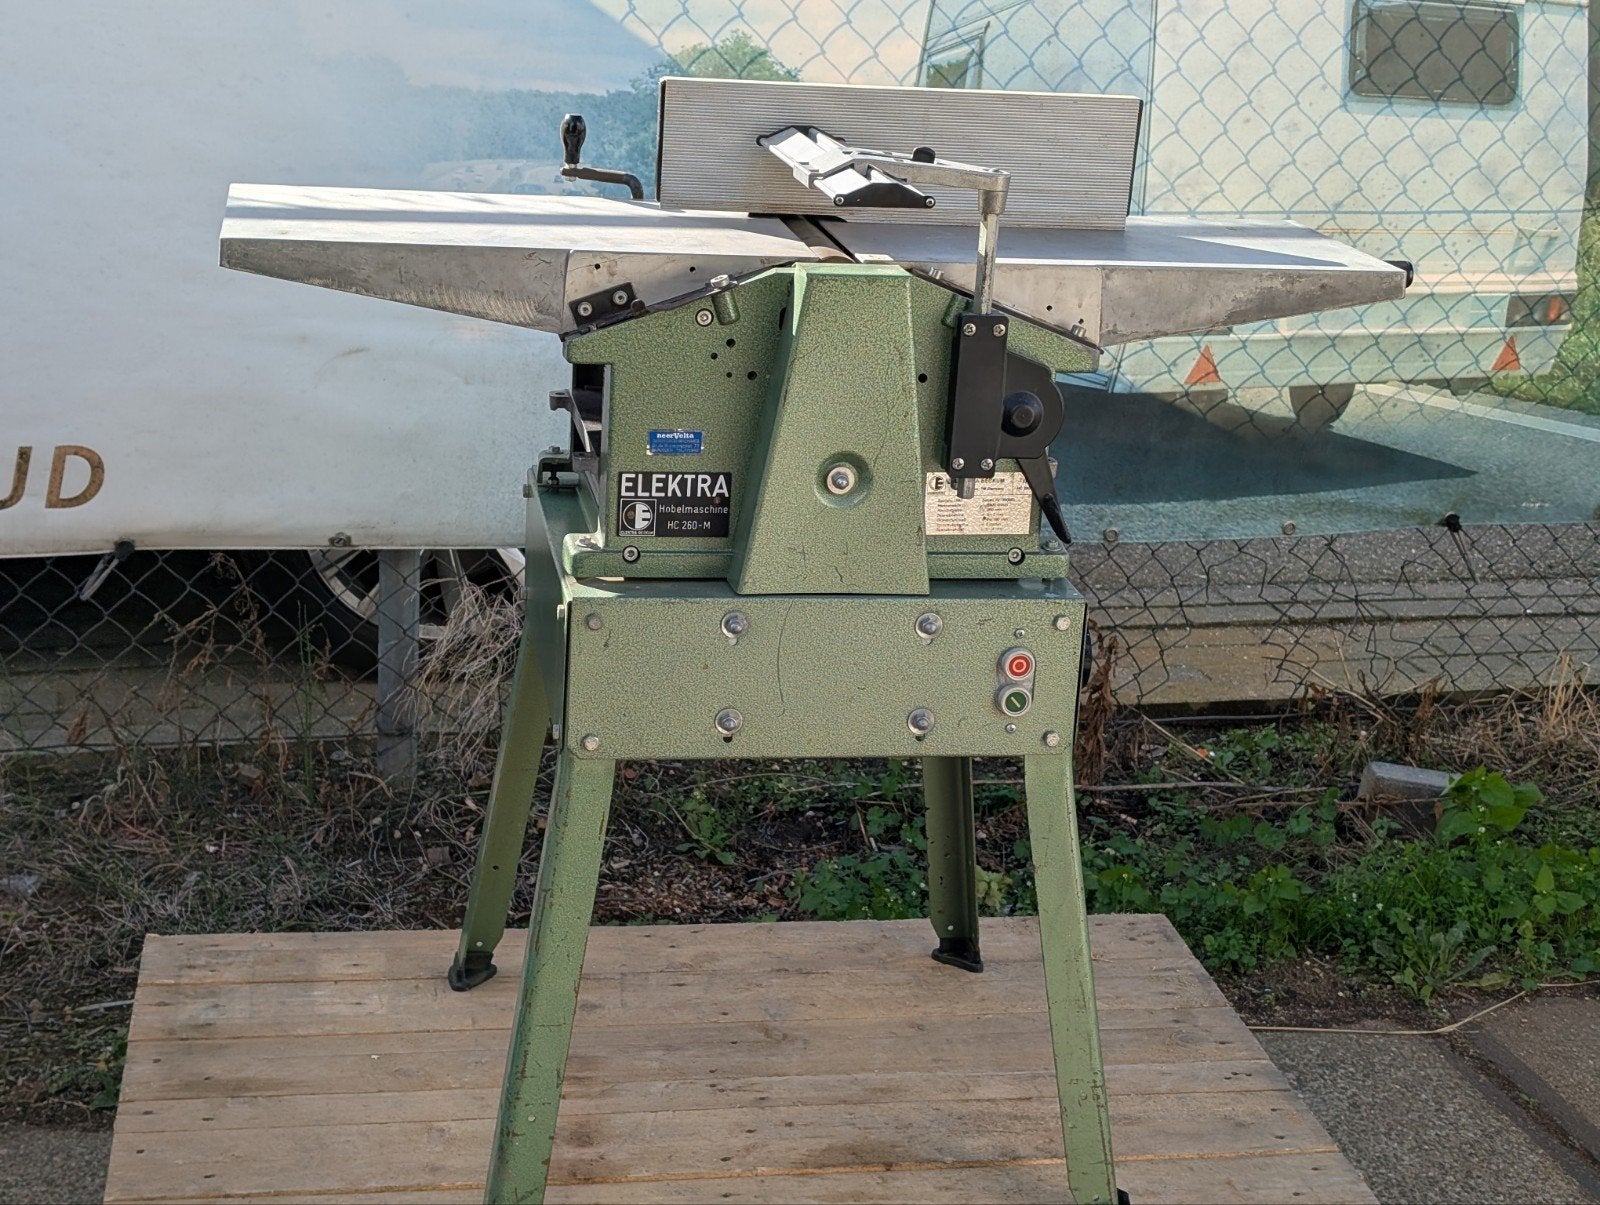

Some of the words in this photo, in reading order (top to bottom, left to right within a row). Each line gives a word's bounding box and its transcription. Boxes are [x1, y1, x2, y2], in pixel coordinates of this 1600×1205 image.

[620, 473, 730, 498] ELEKTRA
[659, 504, 729, 514] Hobelmaschine
[667, 520, 680, 530] HC
[681, 520, 711, 530] 260-M
